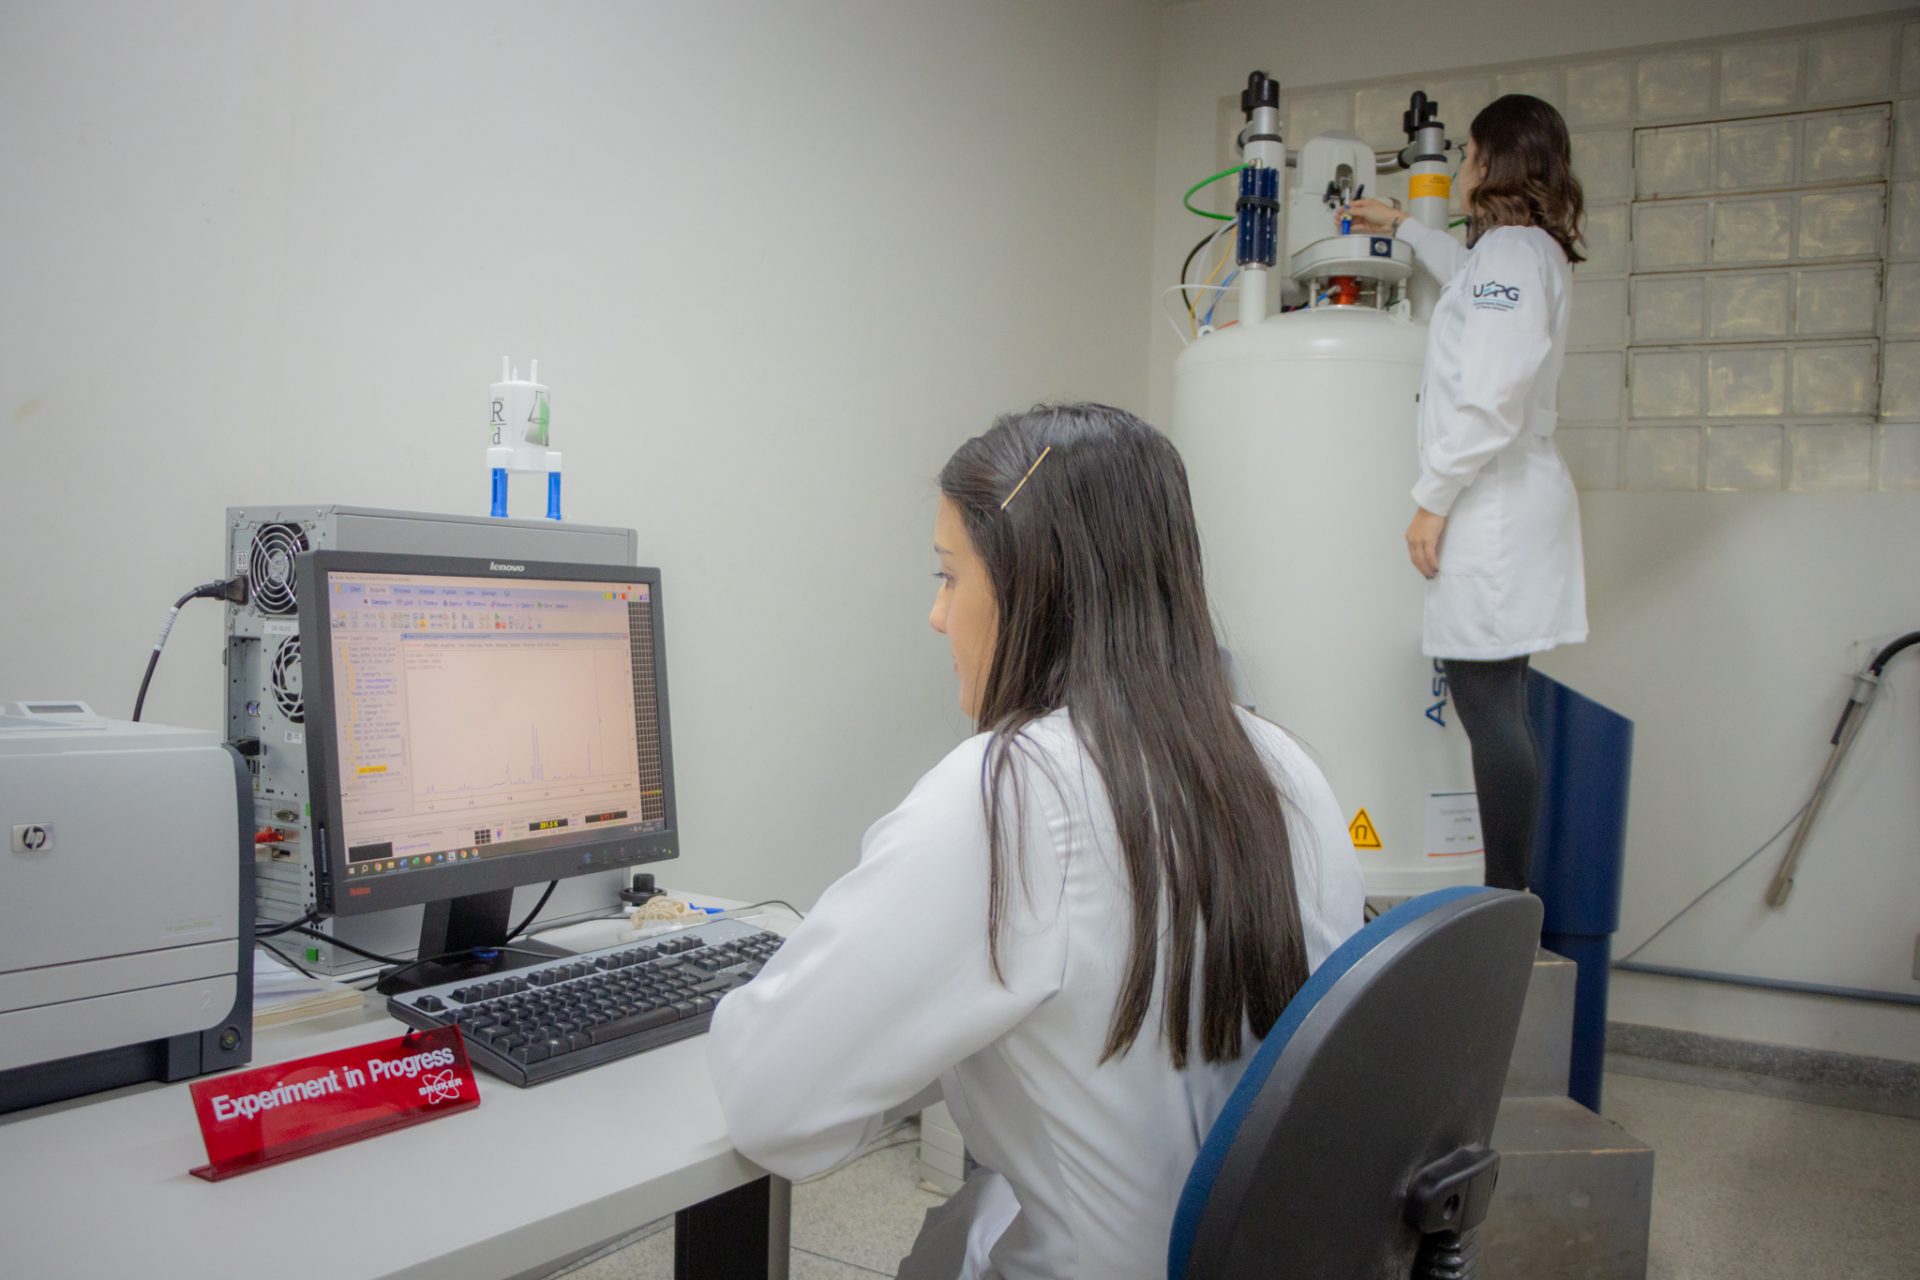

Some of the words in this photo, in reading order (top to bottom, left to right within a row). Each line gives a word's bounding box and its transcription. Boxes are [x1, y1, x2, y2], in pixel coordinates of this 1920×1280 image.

[1473, 280, 1520, 301] UEPG
[491, 400, 505, 422] R
[490, 561, 525, 572] lenovo
[23, 825, 46, 851] hp
[212, 1070, 341, 1122] Experiment
[342, 1066, 365, 1088] in
[367, 1047, 456, 1083] Progress
[419, 1077, 463, 1096] BRUKER
